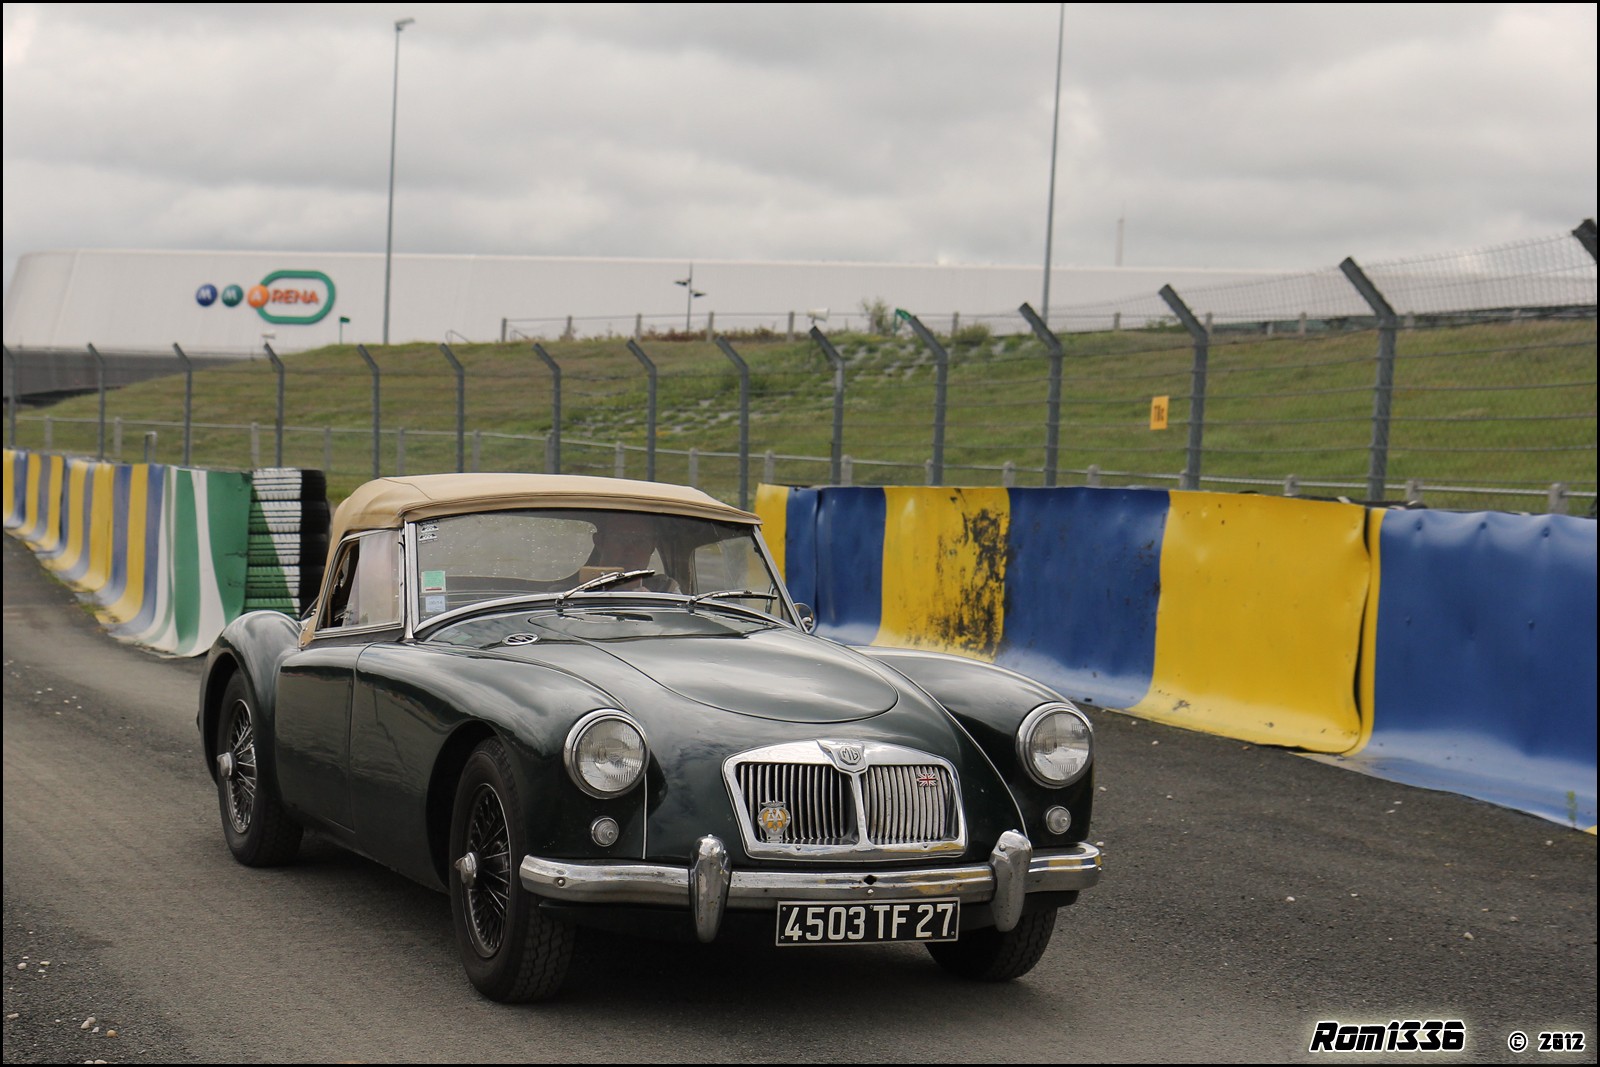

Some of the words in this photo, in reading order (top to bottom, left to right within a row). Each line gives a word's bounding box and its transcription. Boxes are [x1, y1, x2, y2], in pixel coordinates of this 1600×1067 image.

[841, 747, 860, 761] MG
[784, 906, 866, 942] 4503
[872, 905, 911, 940] TF
[915, 903, 955, 939] 27
